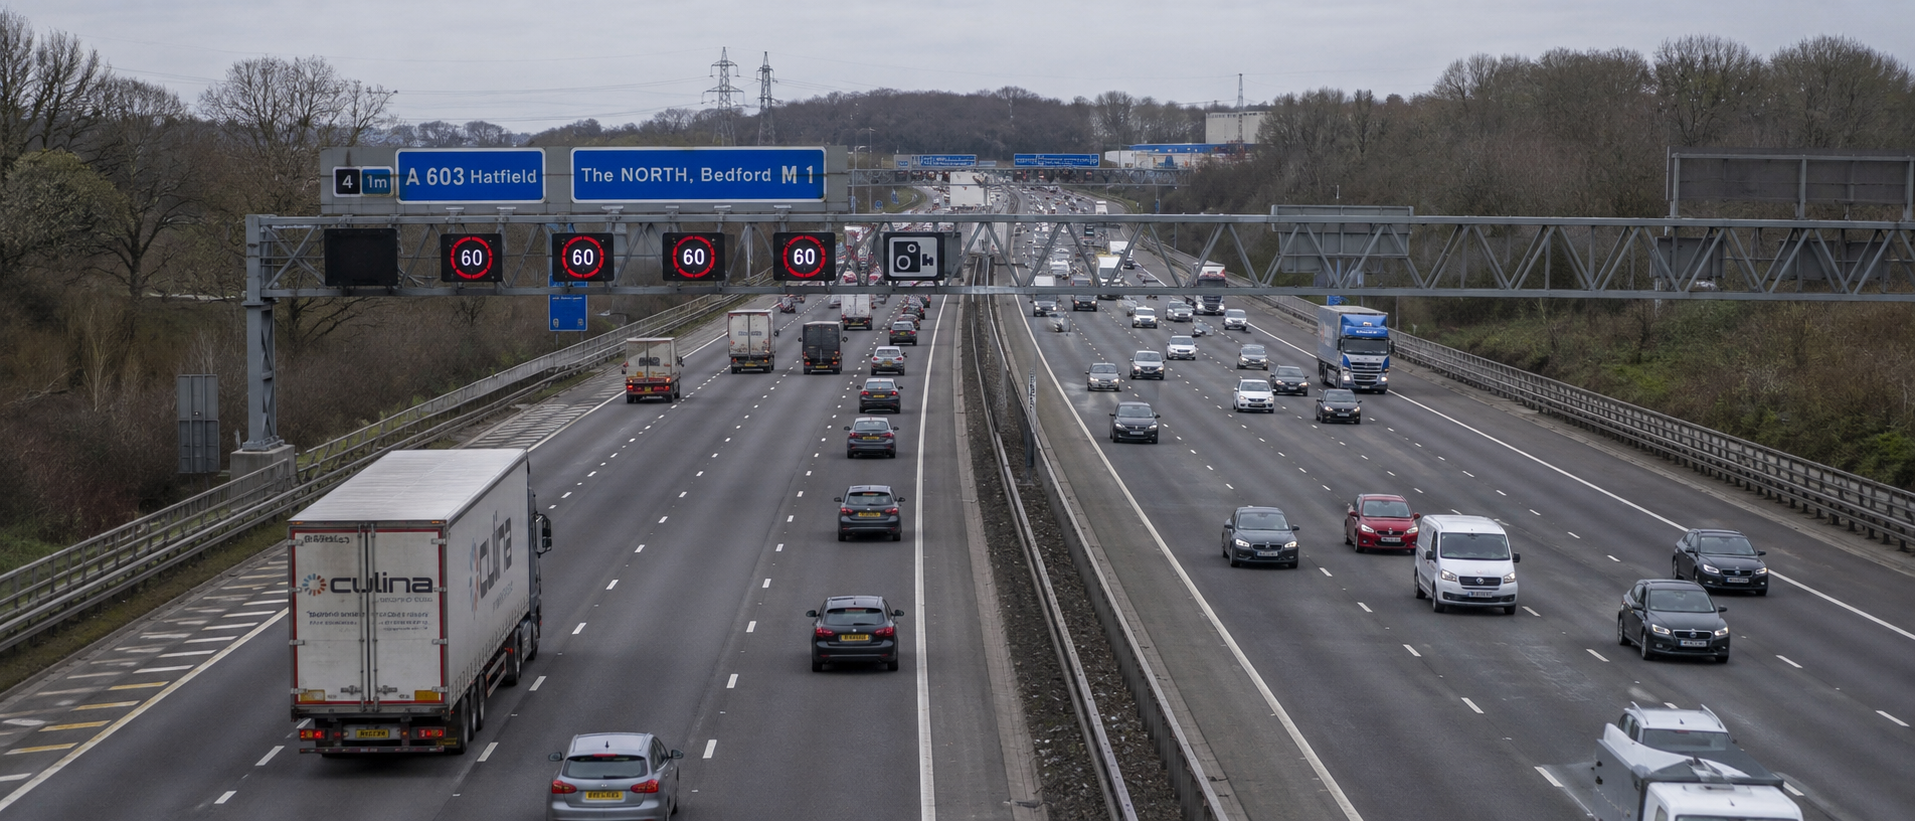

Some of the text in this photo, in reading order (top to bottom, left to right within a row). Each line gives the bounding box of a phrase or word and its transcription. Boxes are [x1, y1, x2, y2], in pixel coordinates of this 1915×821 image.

[342, 175, 353, 189] 4
[367, 175, 387, 189] 1m
[405, 167, 537, 186] A 603 Hatfield
[581, 165, 813, 184] The NORTH, Bedford M 1
[461, 249, 483, 266] 60
[572, 248, 594, 266] 60
[683, 248, 705, 266] 60
[793, 247, 816, 266] 60
[330, 571, 433, 594] culina
